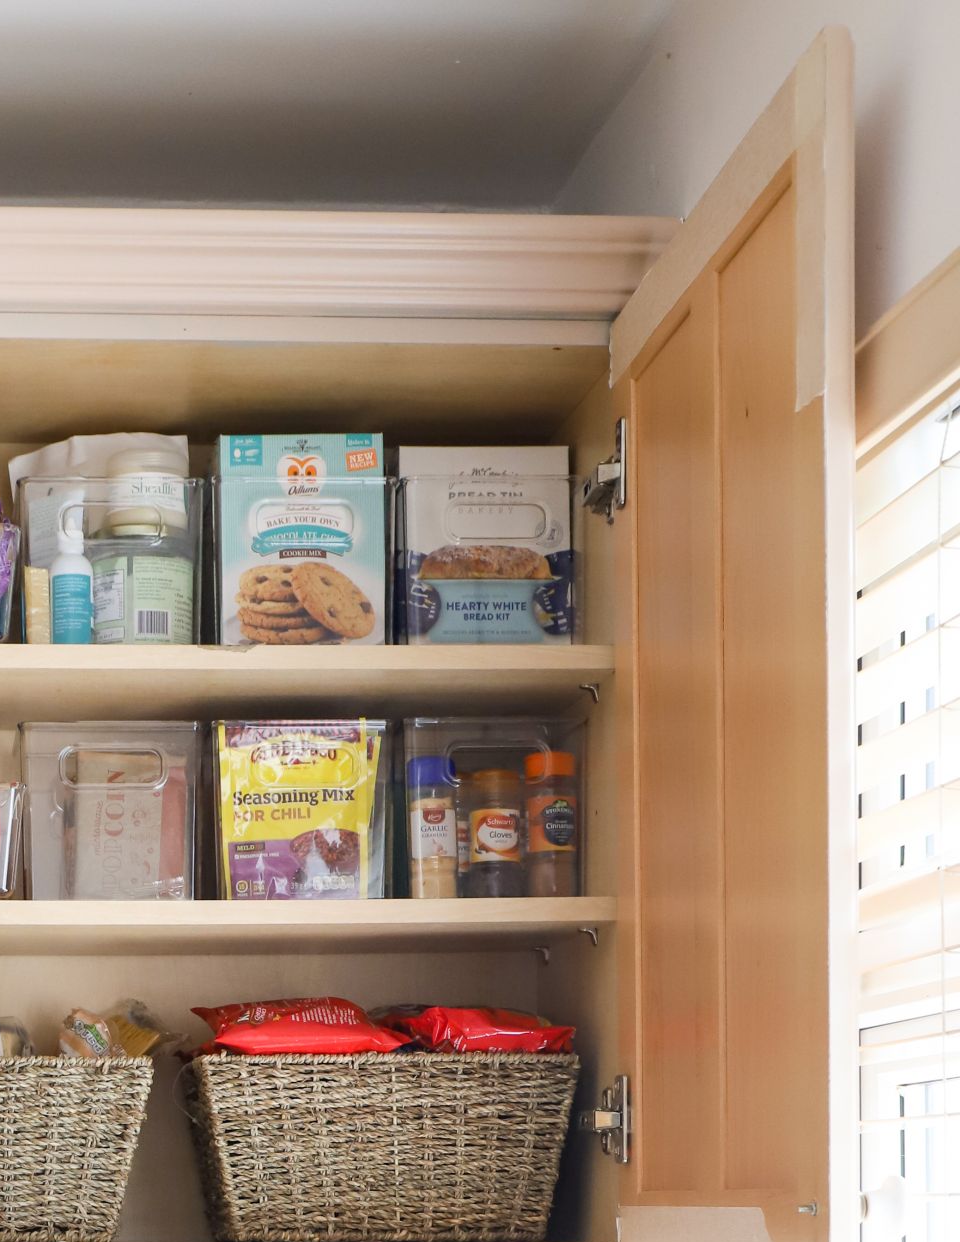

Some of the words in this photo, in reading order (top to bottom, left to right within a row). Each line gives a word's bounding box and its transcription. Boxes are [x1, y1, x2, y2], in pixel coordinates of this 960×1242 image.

[349, 452, 374, 463] NEW
[350, 461, 374, 469] RECIPE
[288, 485, 319, 496] Odlums
[266, 516, 293, 528] BAKE
[294, 515, 317, 523] YOUR
[319, 516, 340, 527] OWN
[446, 602, 490, 611] HEARTY
[493, 602, 527, 611] WHITE
[463, 613, 494, 621] BREAD
[496, 613, 511, 621] KIT
[233, 789, 319, 805] Seasoning
[322, 788, 355, 801] Mix
[233, 809, 265, 822] FOR
[271, 808, 311, 819] CHILI
[420, 825, 448, 833] GARLIC
[490, 830, 513, 838] Cloves
